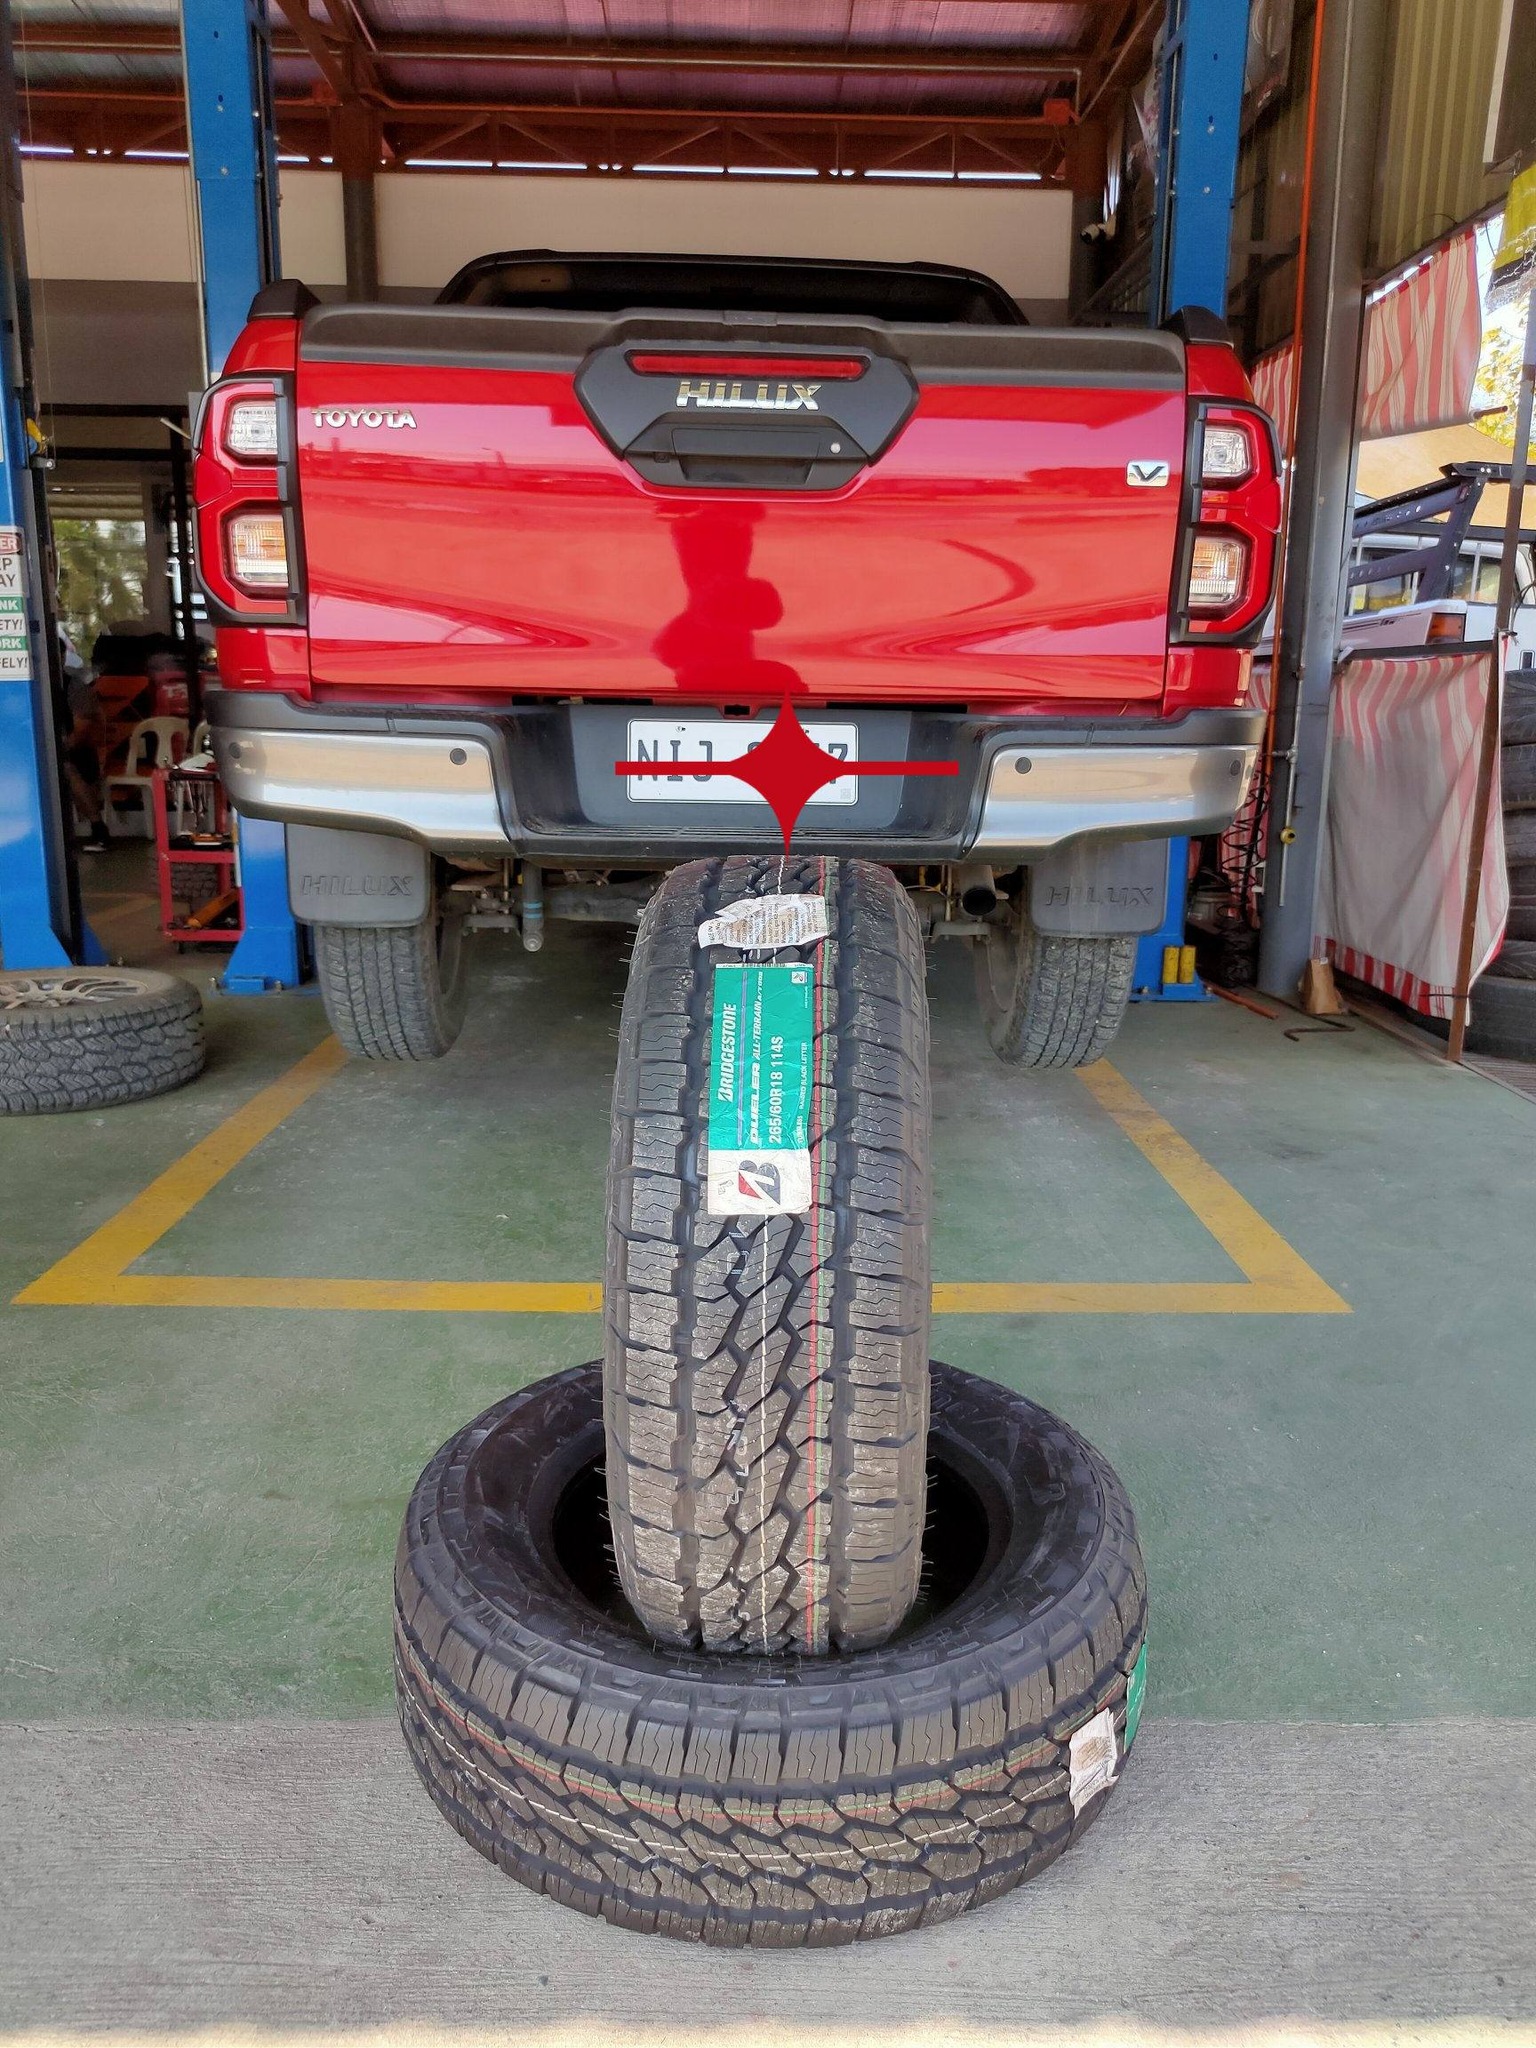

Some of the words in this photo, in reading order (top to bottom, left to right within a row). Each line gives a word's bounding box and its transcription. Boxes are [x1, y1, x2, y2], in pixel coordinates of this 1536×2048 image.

[675, 381, 822, 410] HILUX
[311, 408, 417, 429] TOYOTA
[1130, 463, 1167, 484] V
[0, 638, 22, 649] RK
[0, 657, 28, 668] ELY!
[302, 875, 413, 896] HILUX
[752, 1001, 763, 1060] ALL-TERRAIN
[717, 1002, 737, 1103] BRIDGESTONE
[770, 1036, 784, 1068] 114S
[749, 1062, 761, 1144] DUELER
[768, 1071, 783, 1144] 265/60R18
